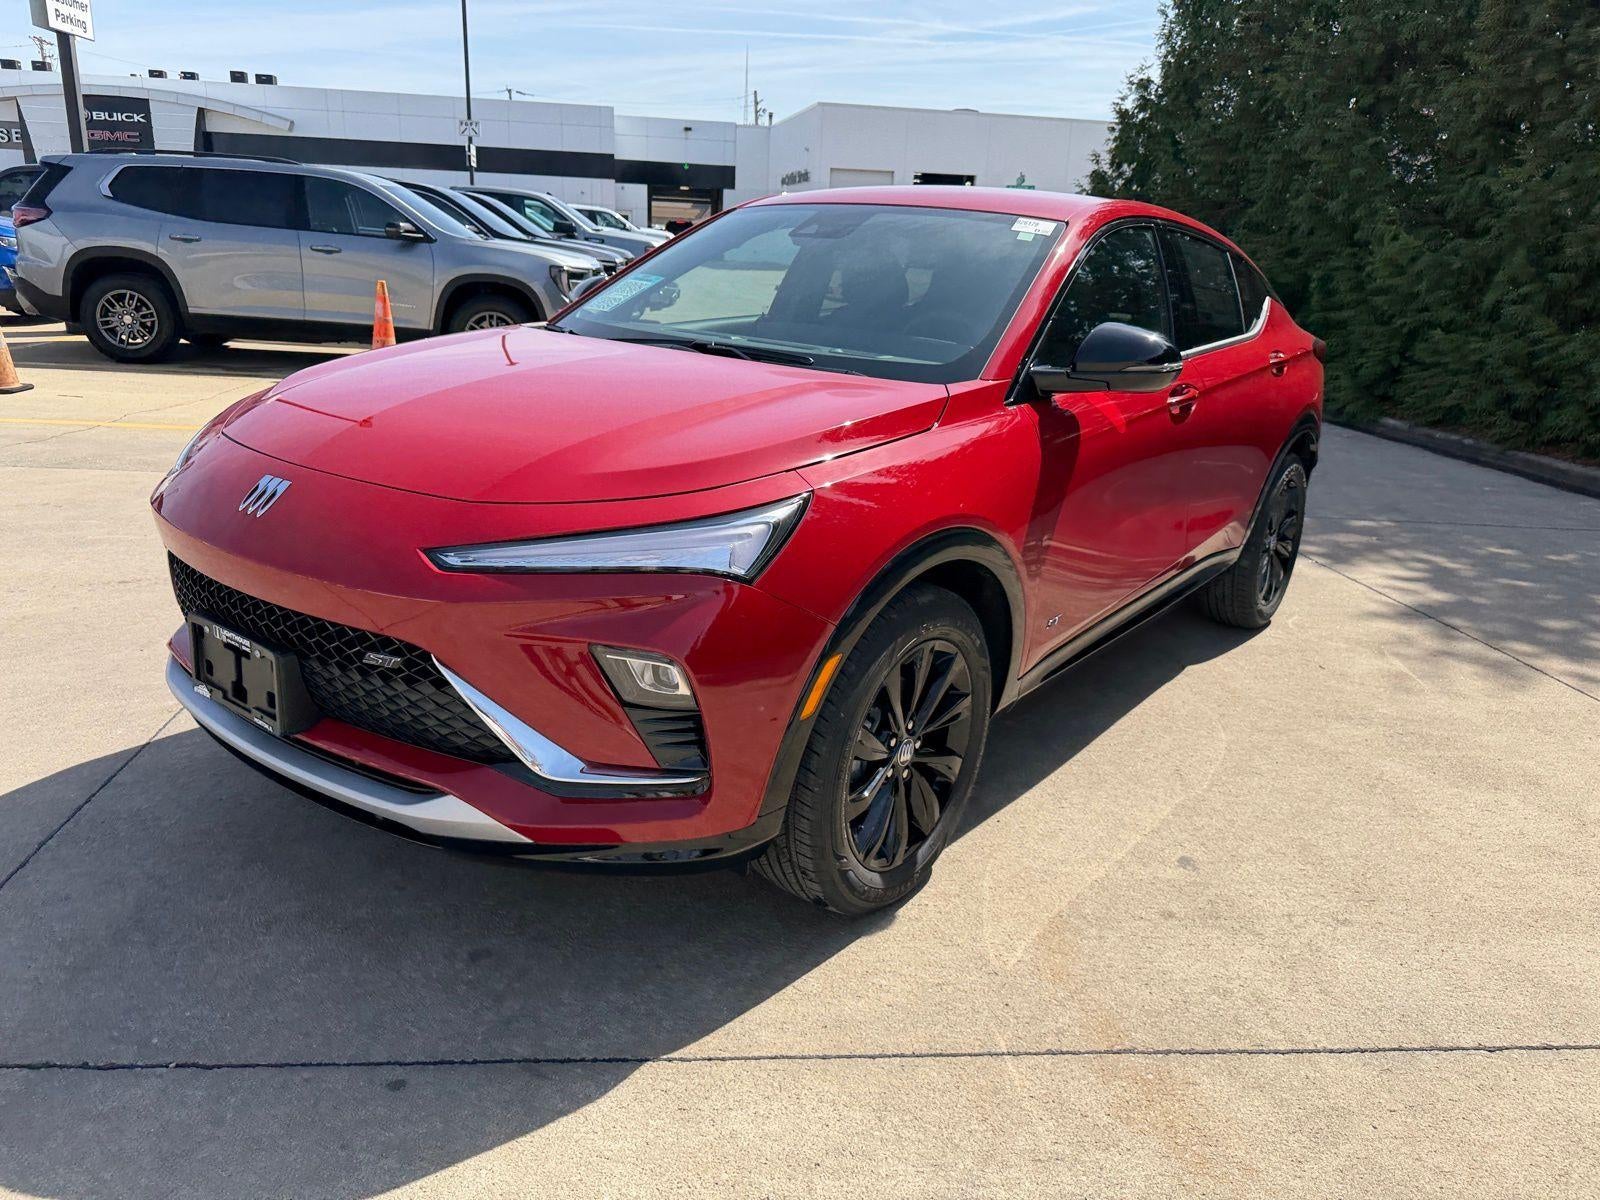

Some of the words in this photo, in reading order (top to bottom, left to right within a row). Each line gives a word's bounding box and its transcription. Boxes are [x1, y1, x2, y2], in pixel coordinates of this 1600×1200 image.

[51, 0, 88, 12] stomer
[55, 8, 87, 33] Parking
[92, 111, 147, 123] BUICK
[87, 129, 140, 142] GMC
[362, 652, 401, 668] ST
